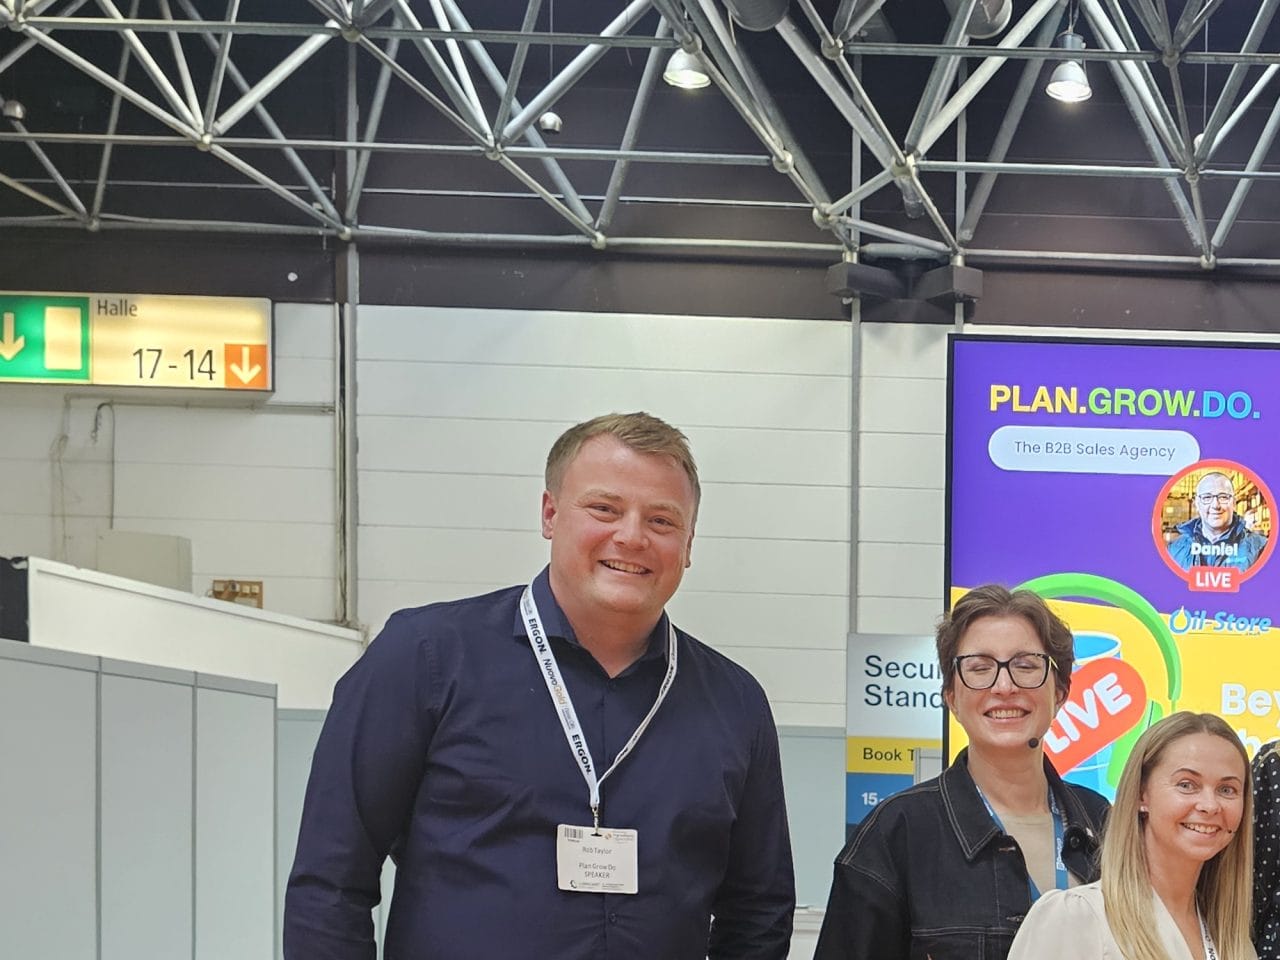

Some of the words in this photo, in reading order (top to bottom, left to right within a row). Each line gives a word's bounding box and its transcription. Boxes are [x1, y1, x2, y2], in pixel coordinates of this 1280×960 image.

[97, 299, 138, 317] Halle
[1014, 441, 1041, 454] The
[1045, 442, 1072, 455] B2B
[1076, 443, 1115, 456] Sales
[1119, 444, 1176, 461] Agency
[1190, 542, 1238, 557] Daniel
[1195, 571, 1232, 588] LIVE
[1169, 606, 1272, 635] Oil-Store
[529, 618, 547, 654] ERGON
[1044, 672, 1132, 755] LIVE
[572, 734, 592, 774] ERGON
[863, 747, 902, 761] Book
